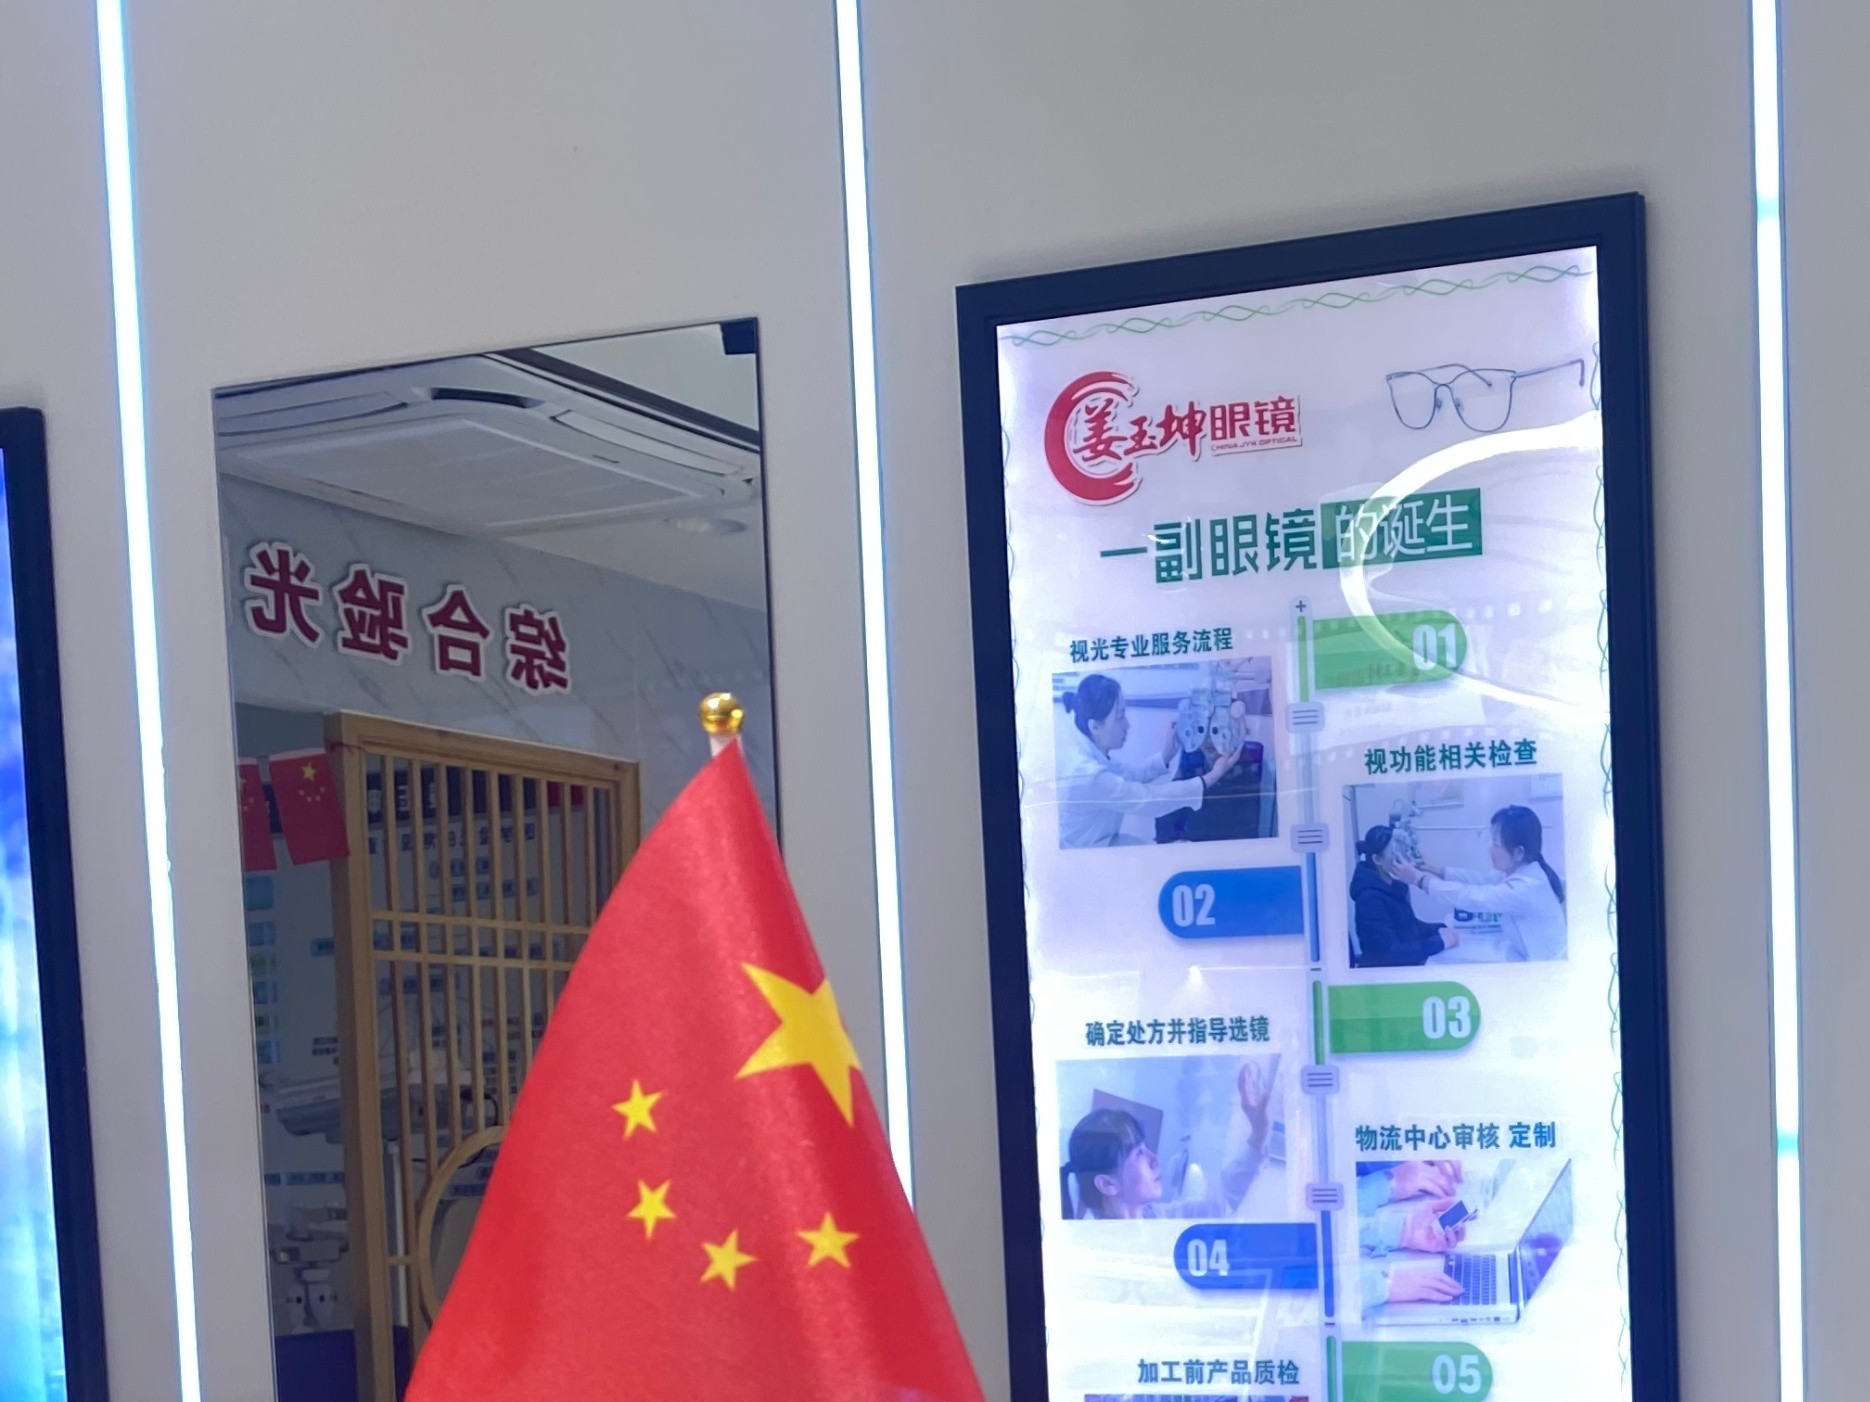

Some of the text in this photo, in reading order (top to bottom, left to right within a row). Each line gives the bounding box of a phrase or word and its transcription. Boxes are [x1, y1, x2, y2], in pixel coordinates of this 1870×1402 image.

[1072, 396, 1296, 461] 姜玉坤眼镜
[1100, 495, 1474, 584] 一副眼镜的诞生
[1070, 627, 1234, 663] 视光专业服务流程
[1413, 622, 1457, 671] 01
[1364, 738, 1538, 775] 视功能相关检查
[1172, 884, 1216, 927] 02
[1086, 1015, 1270, 1047] 确定处方并指导选镜
[1422, 996, 1472, 1039] 03
[1355, 1121, 1556, 1152] 物流中心审核 定制
[1187, 1238, 1230, 1277] 04
[1137, 1358, 1300, 1386] 加工前产品质检
[1431, 1354, 1483, 1395] 05
